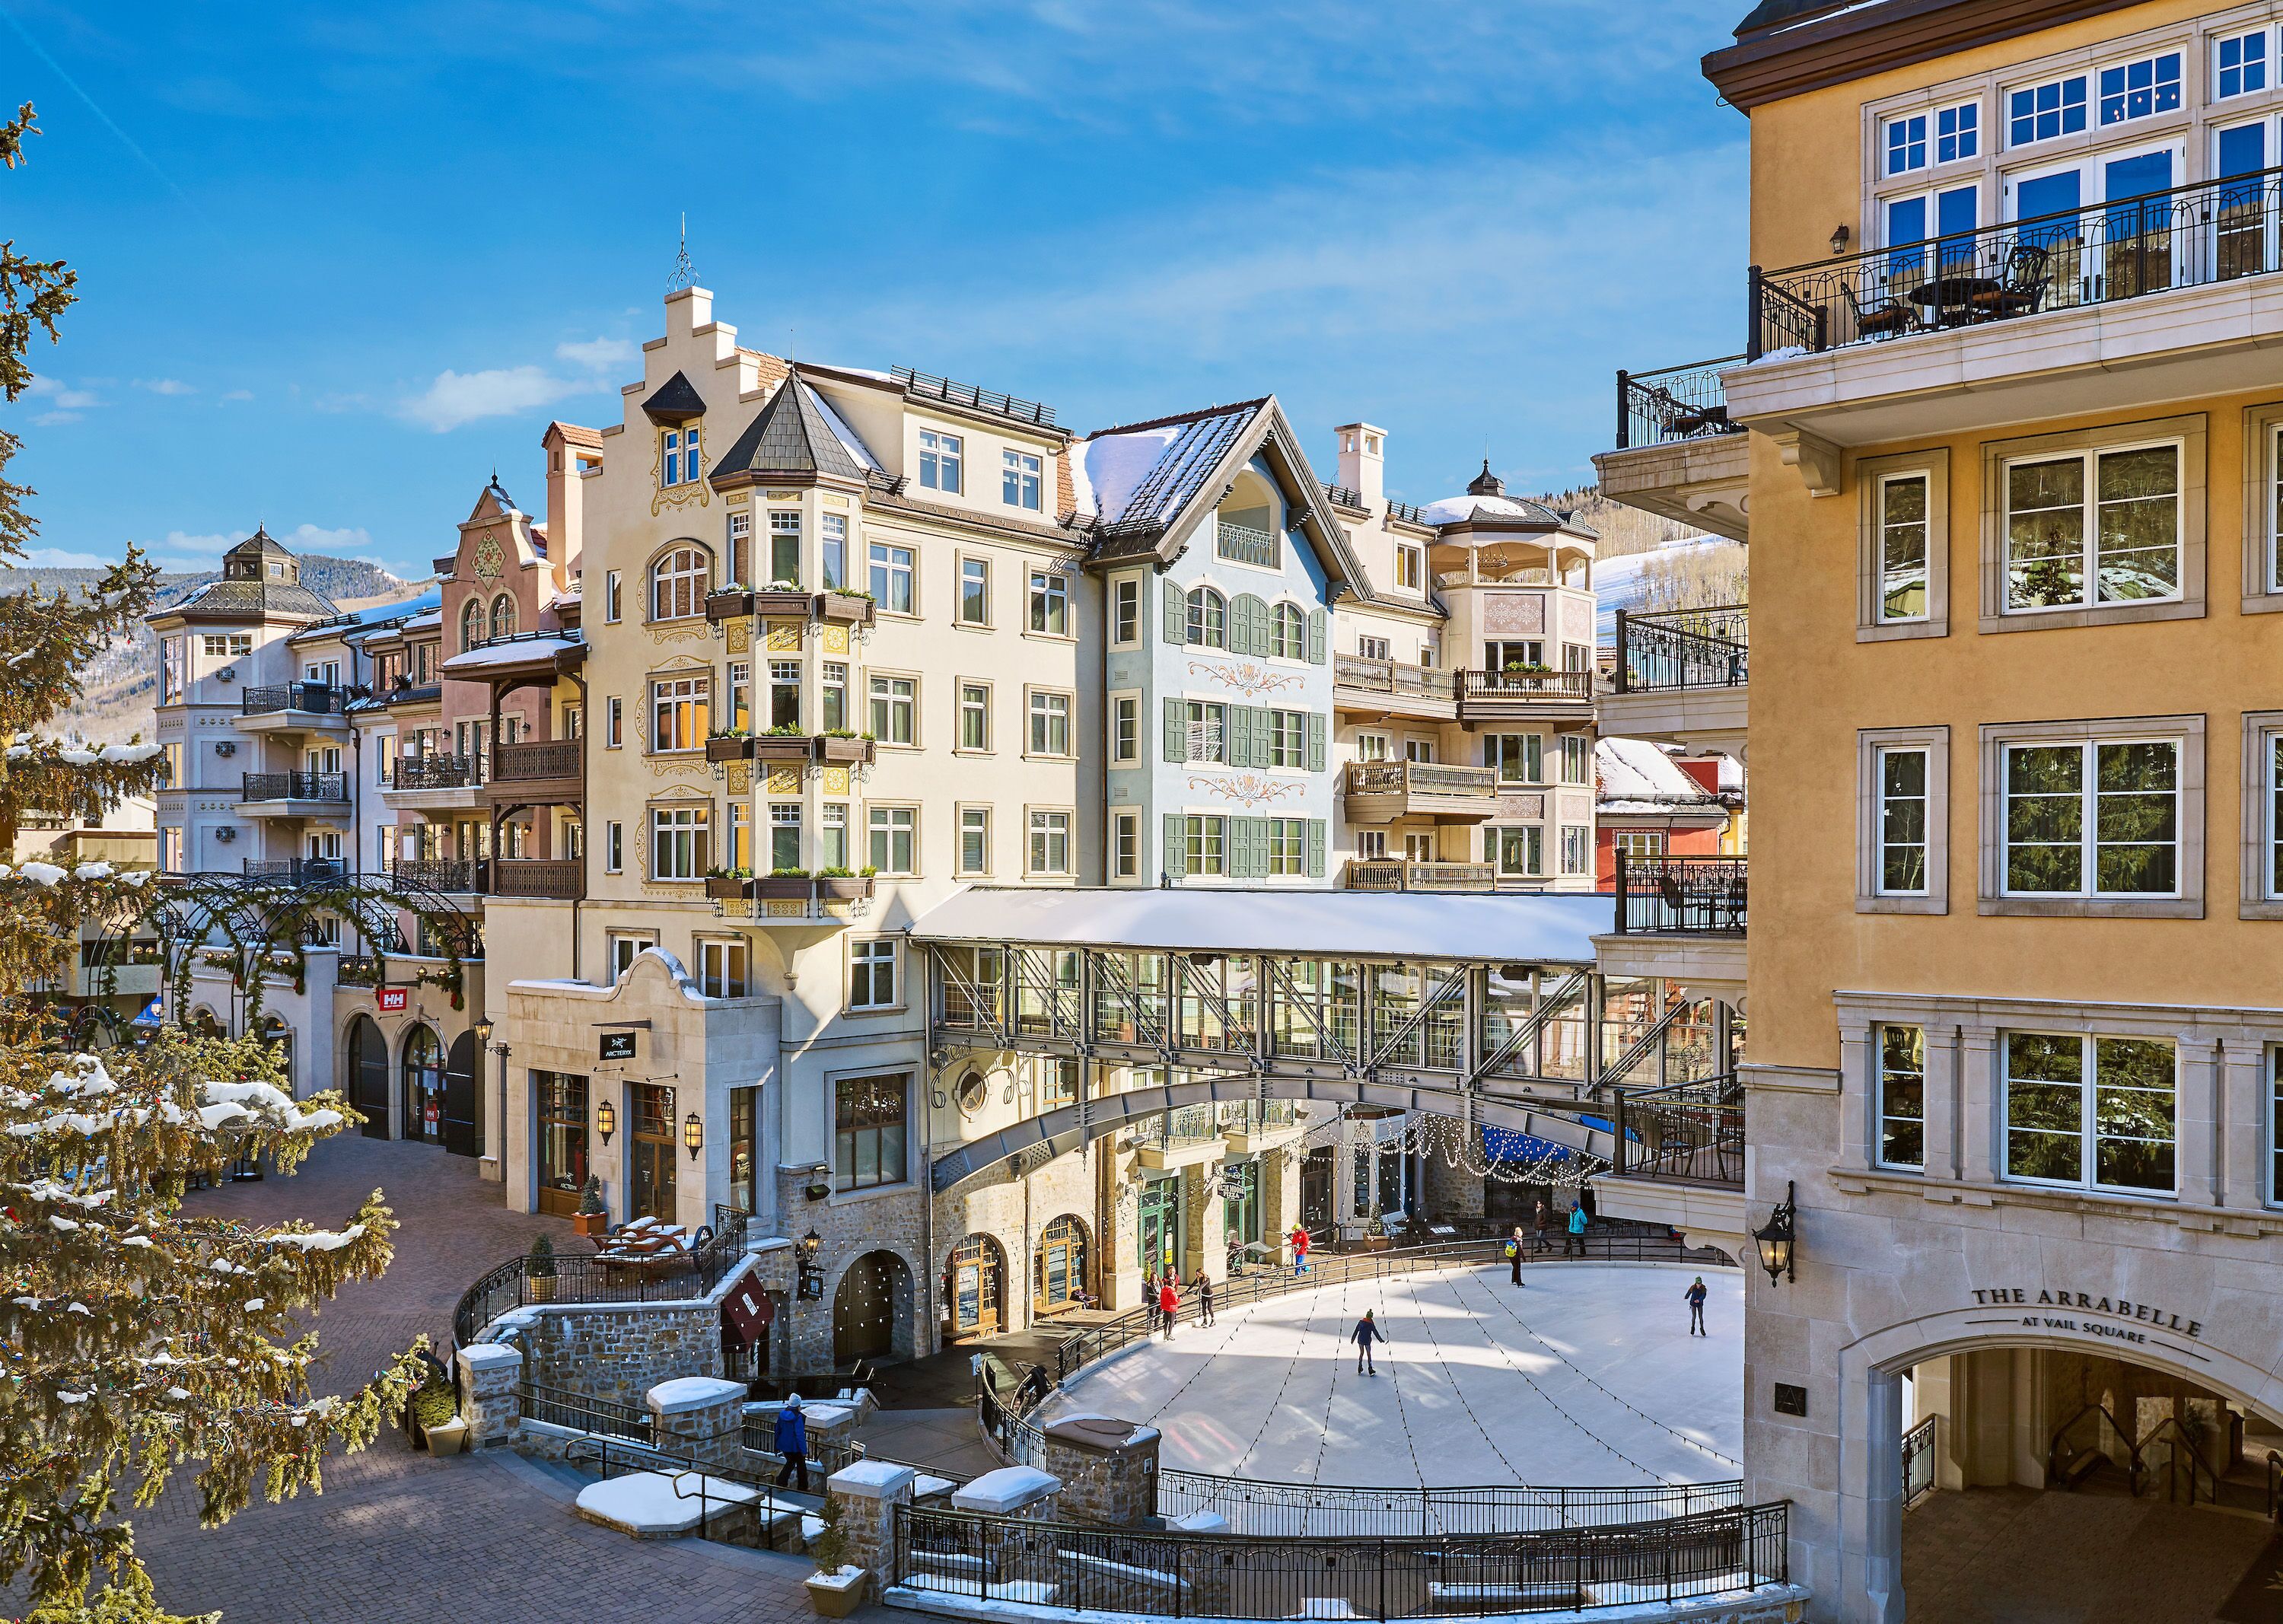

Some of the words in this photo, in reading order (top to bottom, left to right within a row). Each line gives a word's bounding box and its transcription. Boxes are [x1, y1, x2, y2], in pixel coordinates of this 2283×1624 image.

[384, 994, 403, 1005] HH
[1972, 1288, 2024, 1304] THE
[2037, 1290, 2204, 1337] ARRABELLE
[2022, 1317, 2039, 1326] AT
[2044, 1318, 2077, 1330] VAIL
[2083, 1323, 2145, 1344] SQUARE
